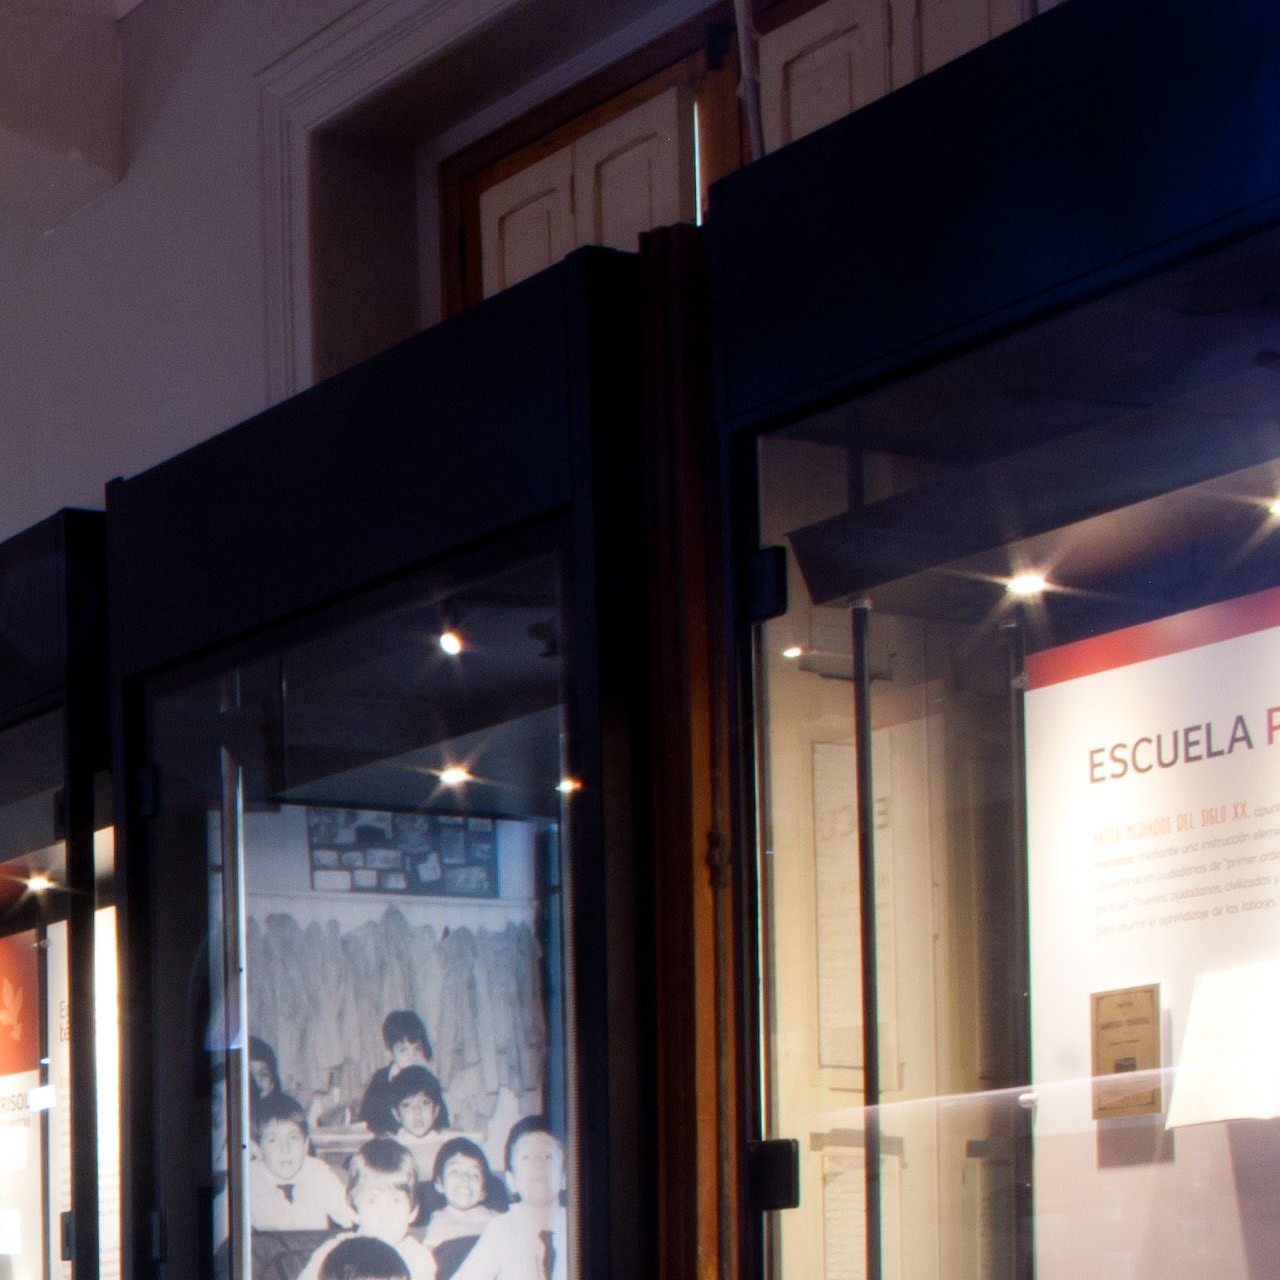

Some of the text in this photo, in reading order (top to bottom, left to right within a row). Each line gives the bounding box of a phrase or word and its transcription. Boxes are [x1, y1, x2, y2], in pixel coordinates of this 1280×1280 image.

[1089, 713, 1254, 784] ESCUELA
[1177, 811, 1196, 831] DEL
[1201, 804, 1226, 827] SIGLO
